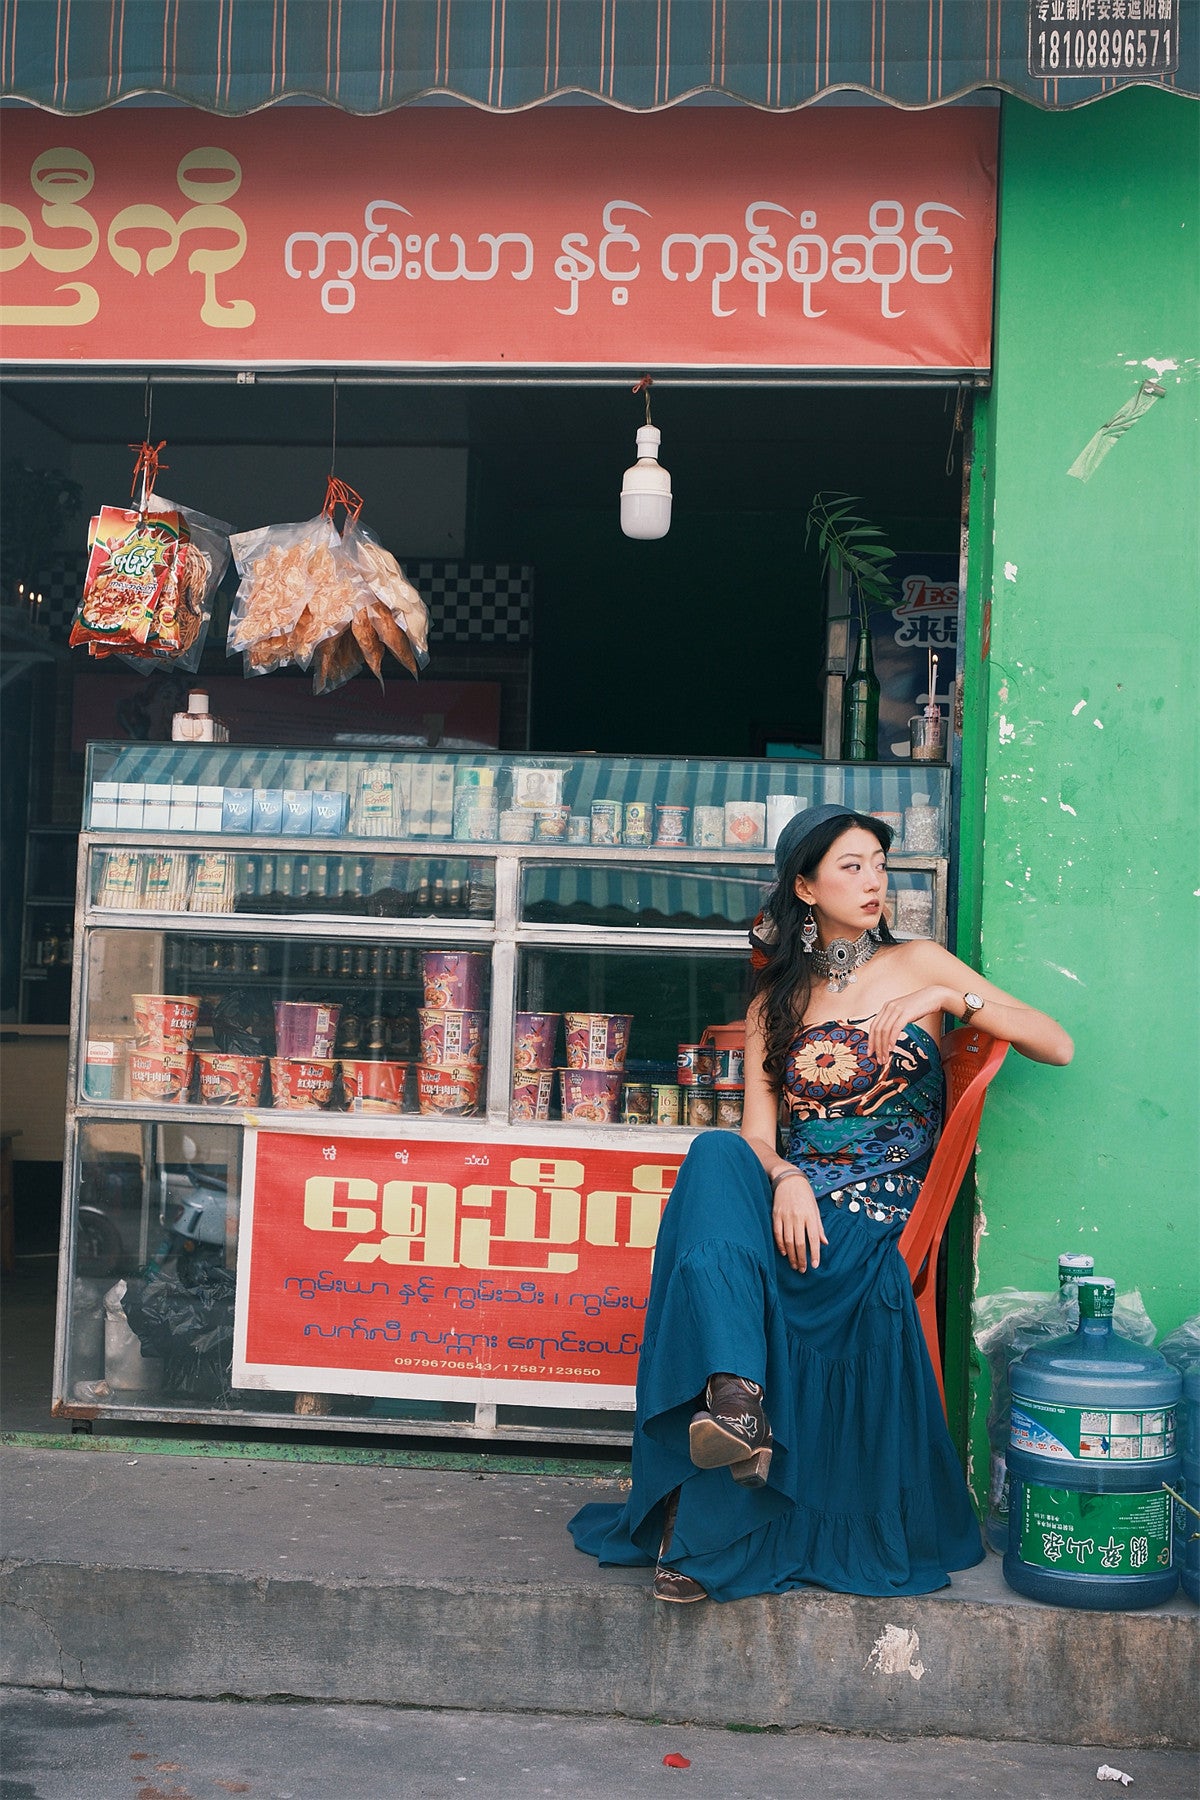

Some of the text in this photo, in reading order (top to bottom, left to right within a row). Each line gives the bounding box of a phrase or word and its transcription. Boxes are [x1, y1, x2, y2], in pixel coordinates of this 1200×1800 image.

[1038, 29, 1171, 69] 18108896571
[285, 200, 534, 314] ကွမ်းယာ
[554, 200, 653, 316] နှင့်
[661, 200, 966, 318] ကုန်စုံဆိုင်
[284, 1271, 389, 1299] ကွမ်းယာ
[444, 1280, 545, 1309] ကွမ်းသီး
[1041, 1531, 1149, 1568] 翡翠山泉
